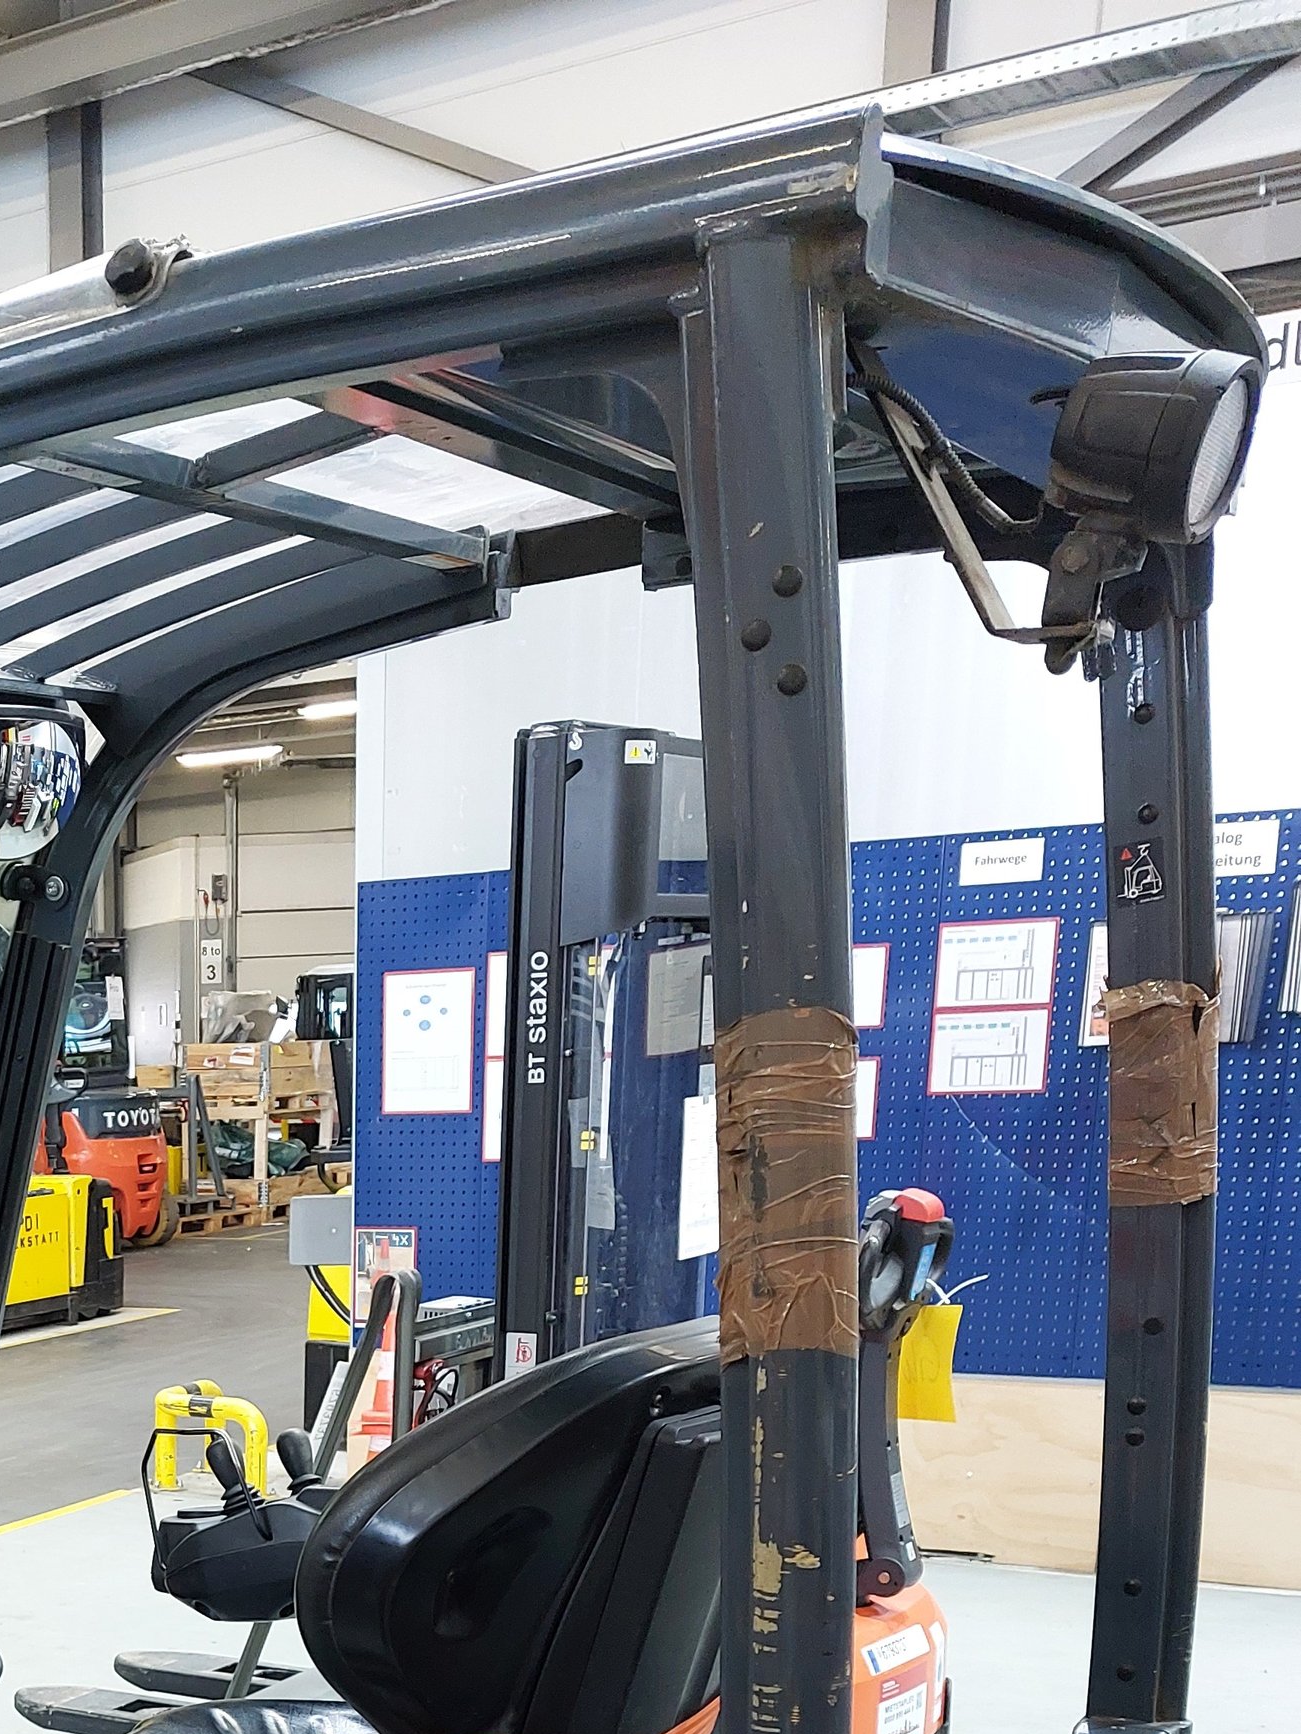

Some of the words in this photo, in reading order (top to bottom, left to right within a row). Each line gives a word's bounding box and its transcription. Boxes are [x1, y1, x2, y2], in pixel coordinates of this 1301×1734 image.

[975, 855, 1027, 866] Fahrwege
[206, 964, 216, 981] 3
[527, 1052, 546, 1084] BT
